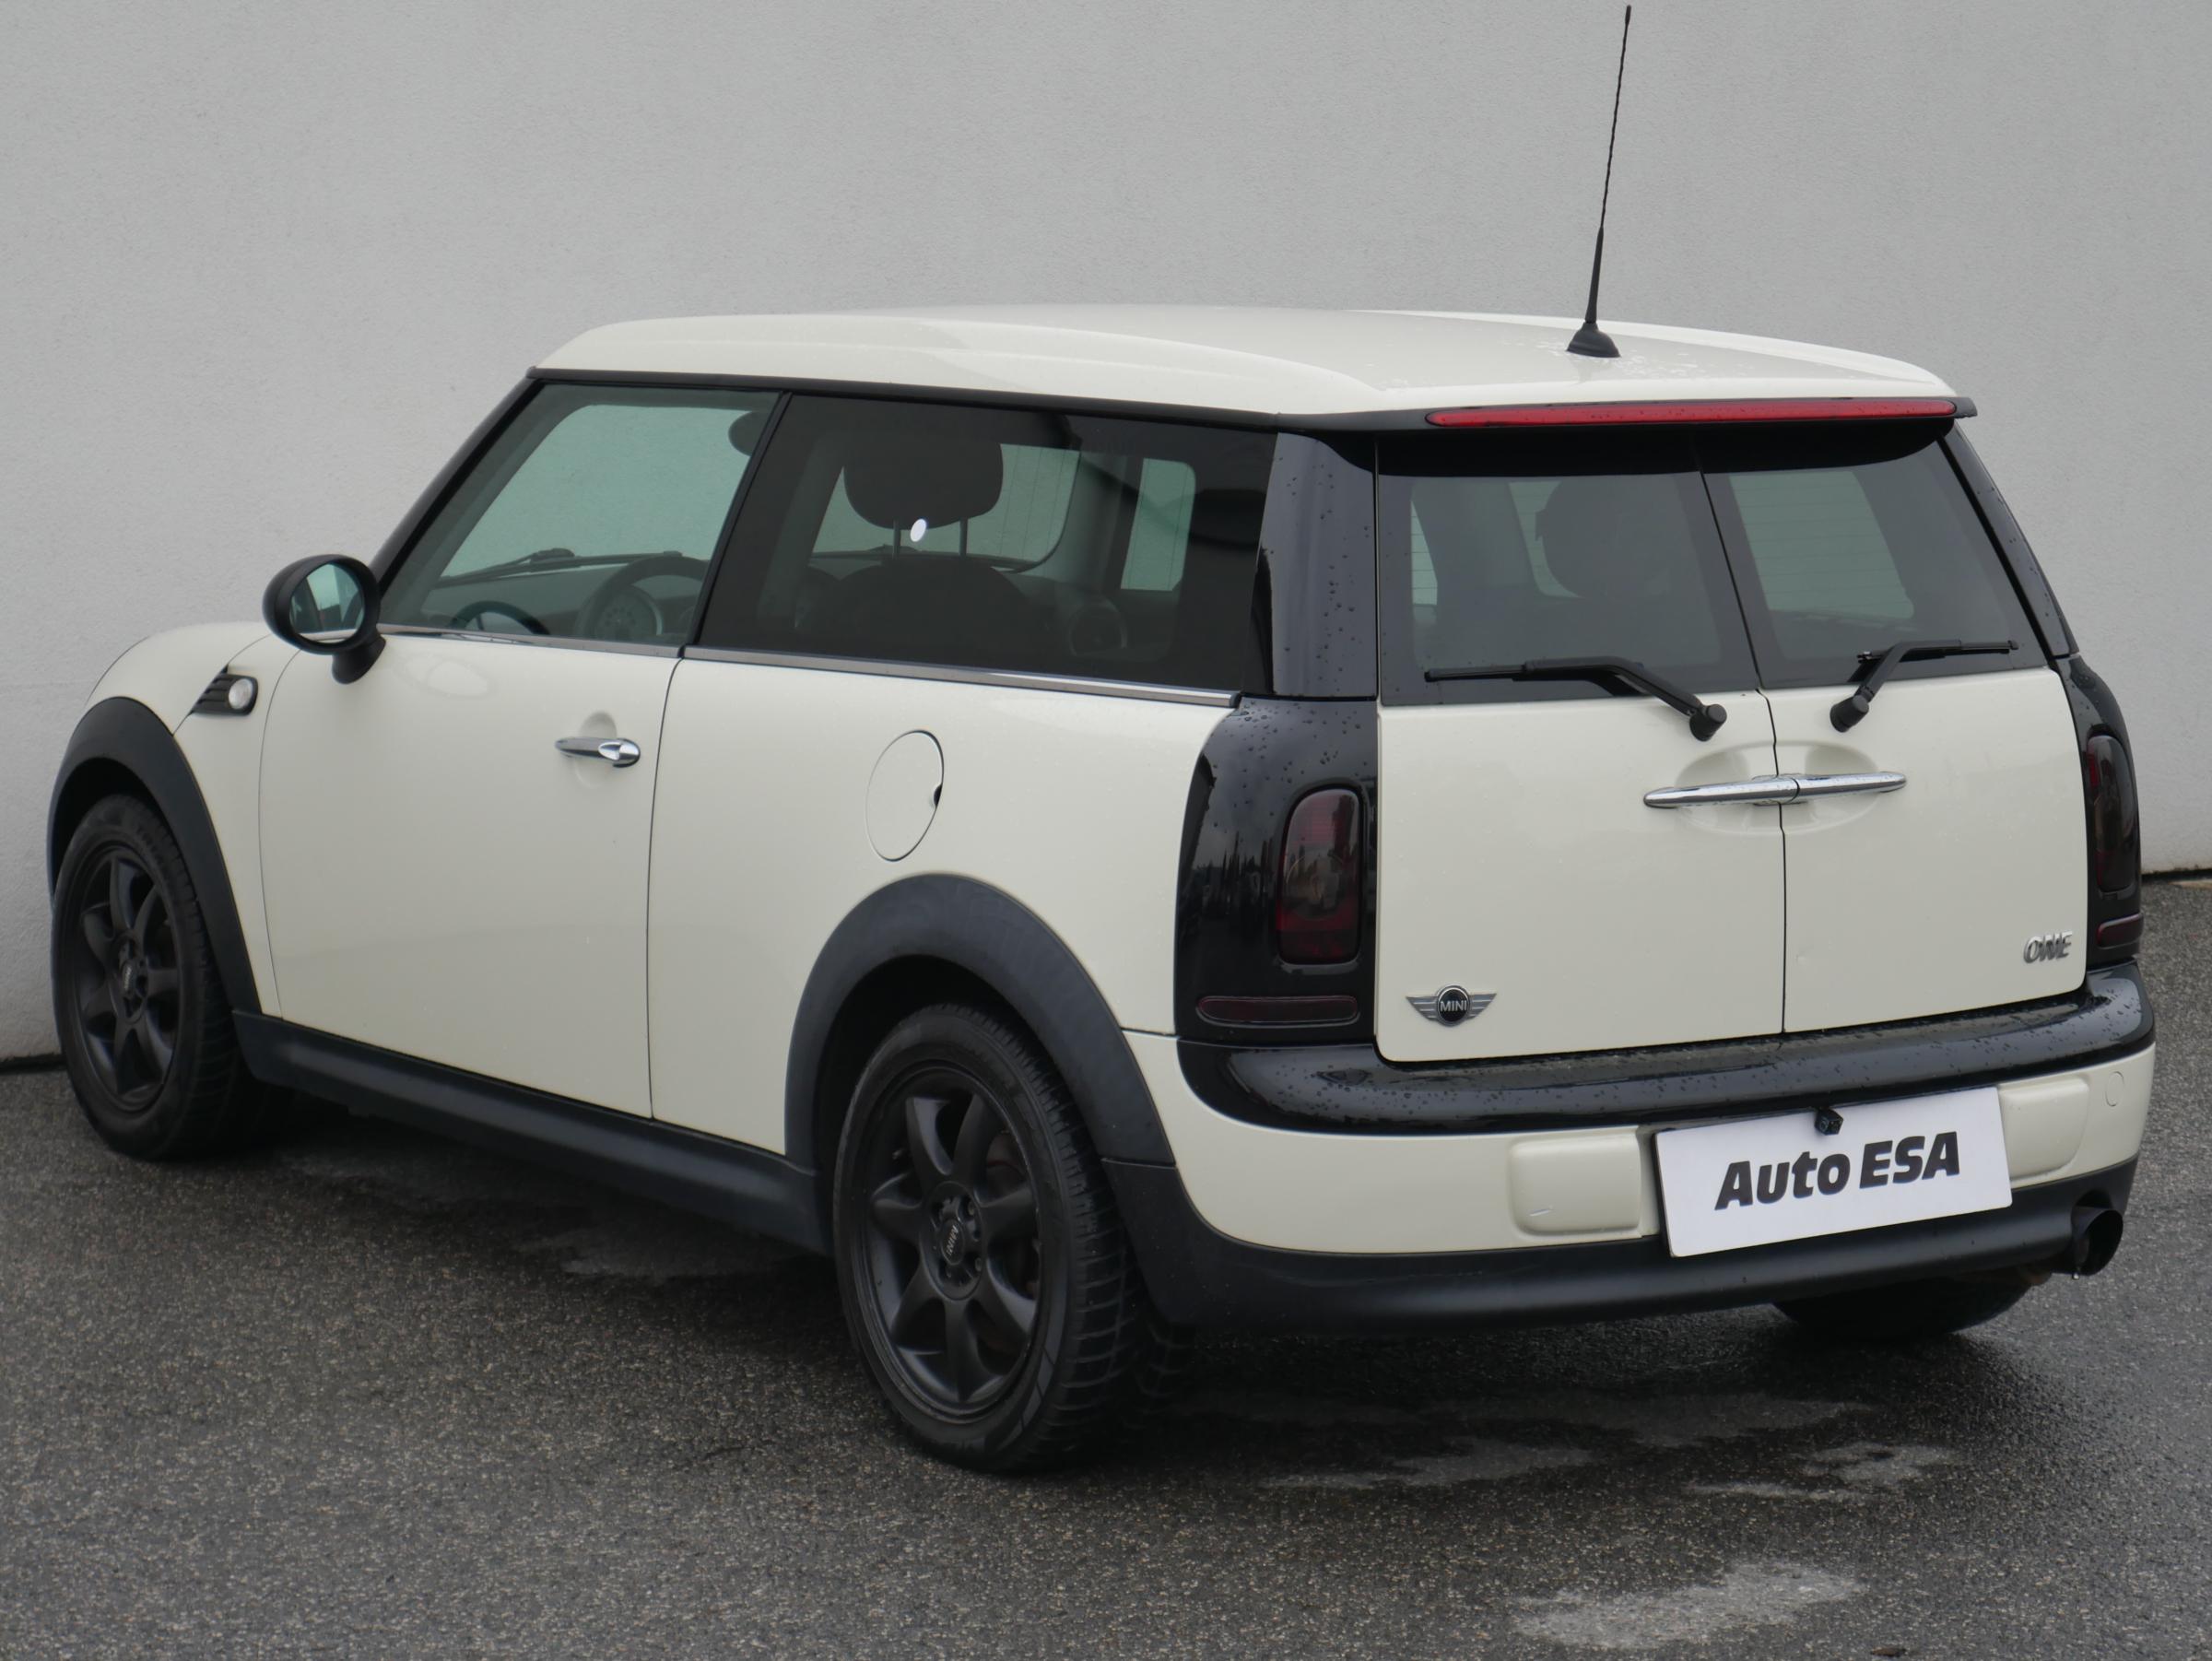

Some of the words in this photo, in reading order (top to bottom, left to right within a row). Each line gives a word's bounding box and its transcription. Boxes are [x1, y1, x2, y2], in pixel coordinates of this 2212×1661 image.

[2023, 931, 2073, 963] ONE
[1440, 1000, 1467, 1012] MINI
[1714, 1151, 1851, 1210] Auto
[1859, 1131, 1959, 1189] ESA
